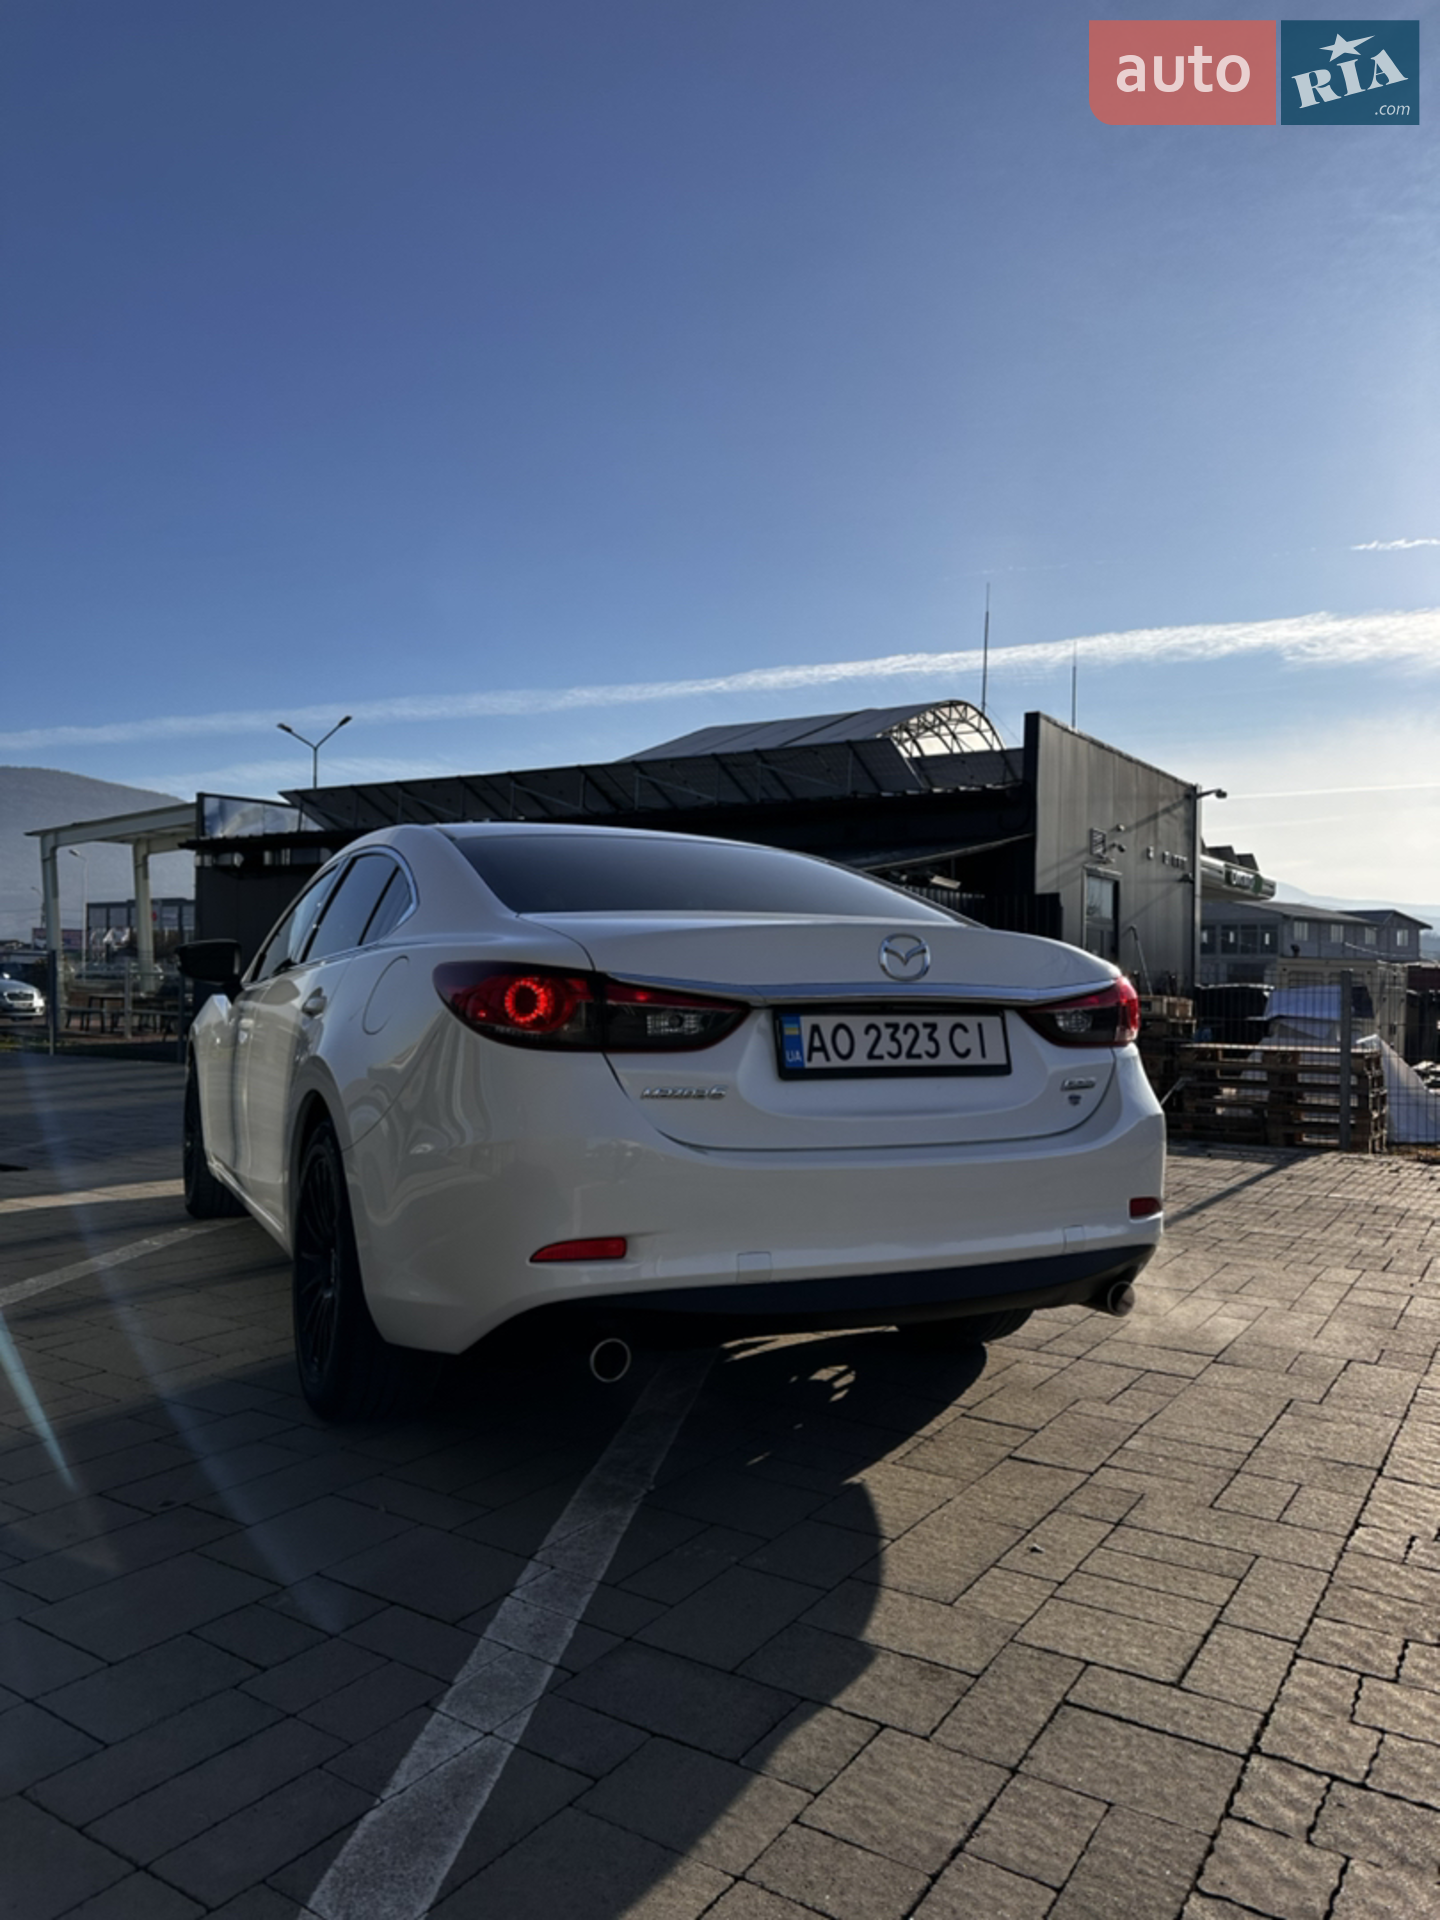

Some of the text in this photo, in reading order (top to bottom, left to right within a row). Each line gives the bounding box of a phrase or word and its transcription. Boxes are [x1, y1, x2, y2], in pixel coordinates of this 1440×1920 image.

[806, 1021, 987, 1063] AO 2323 CI
[785, 1050, 802, 1062] UA
